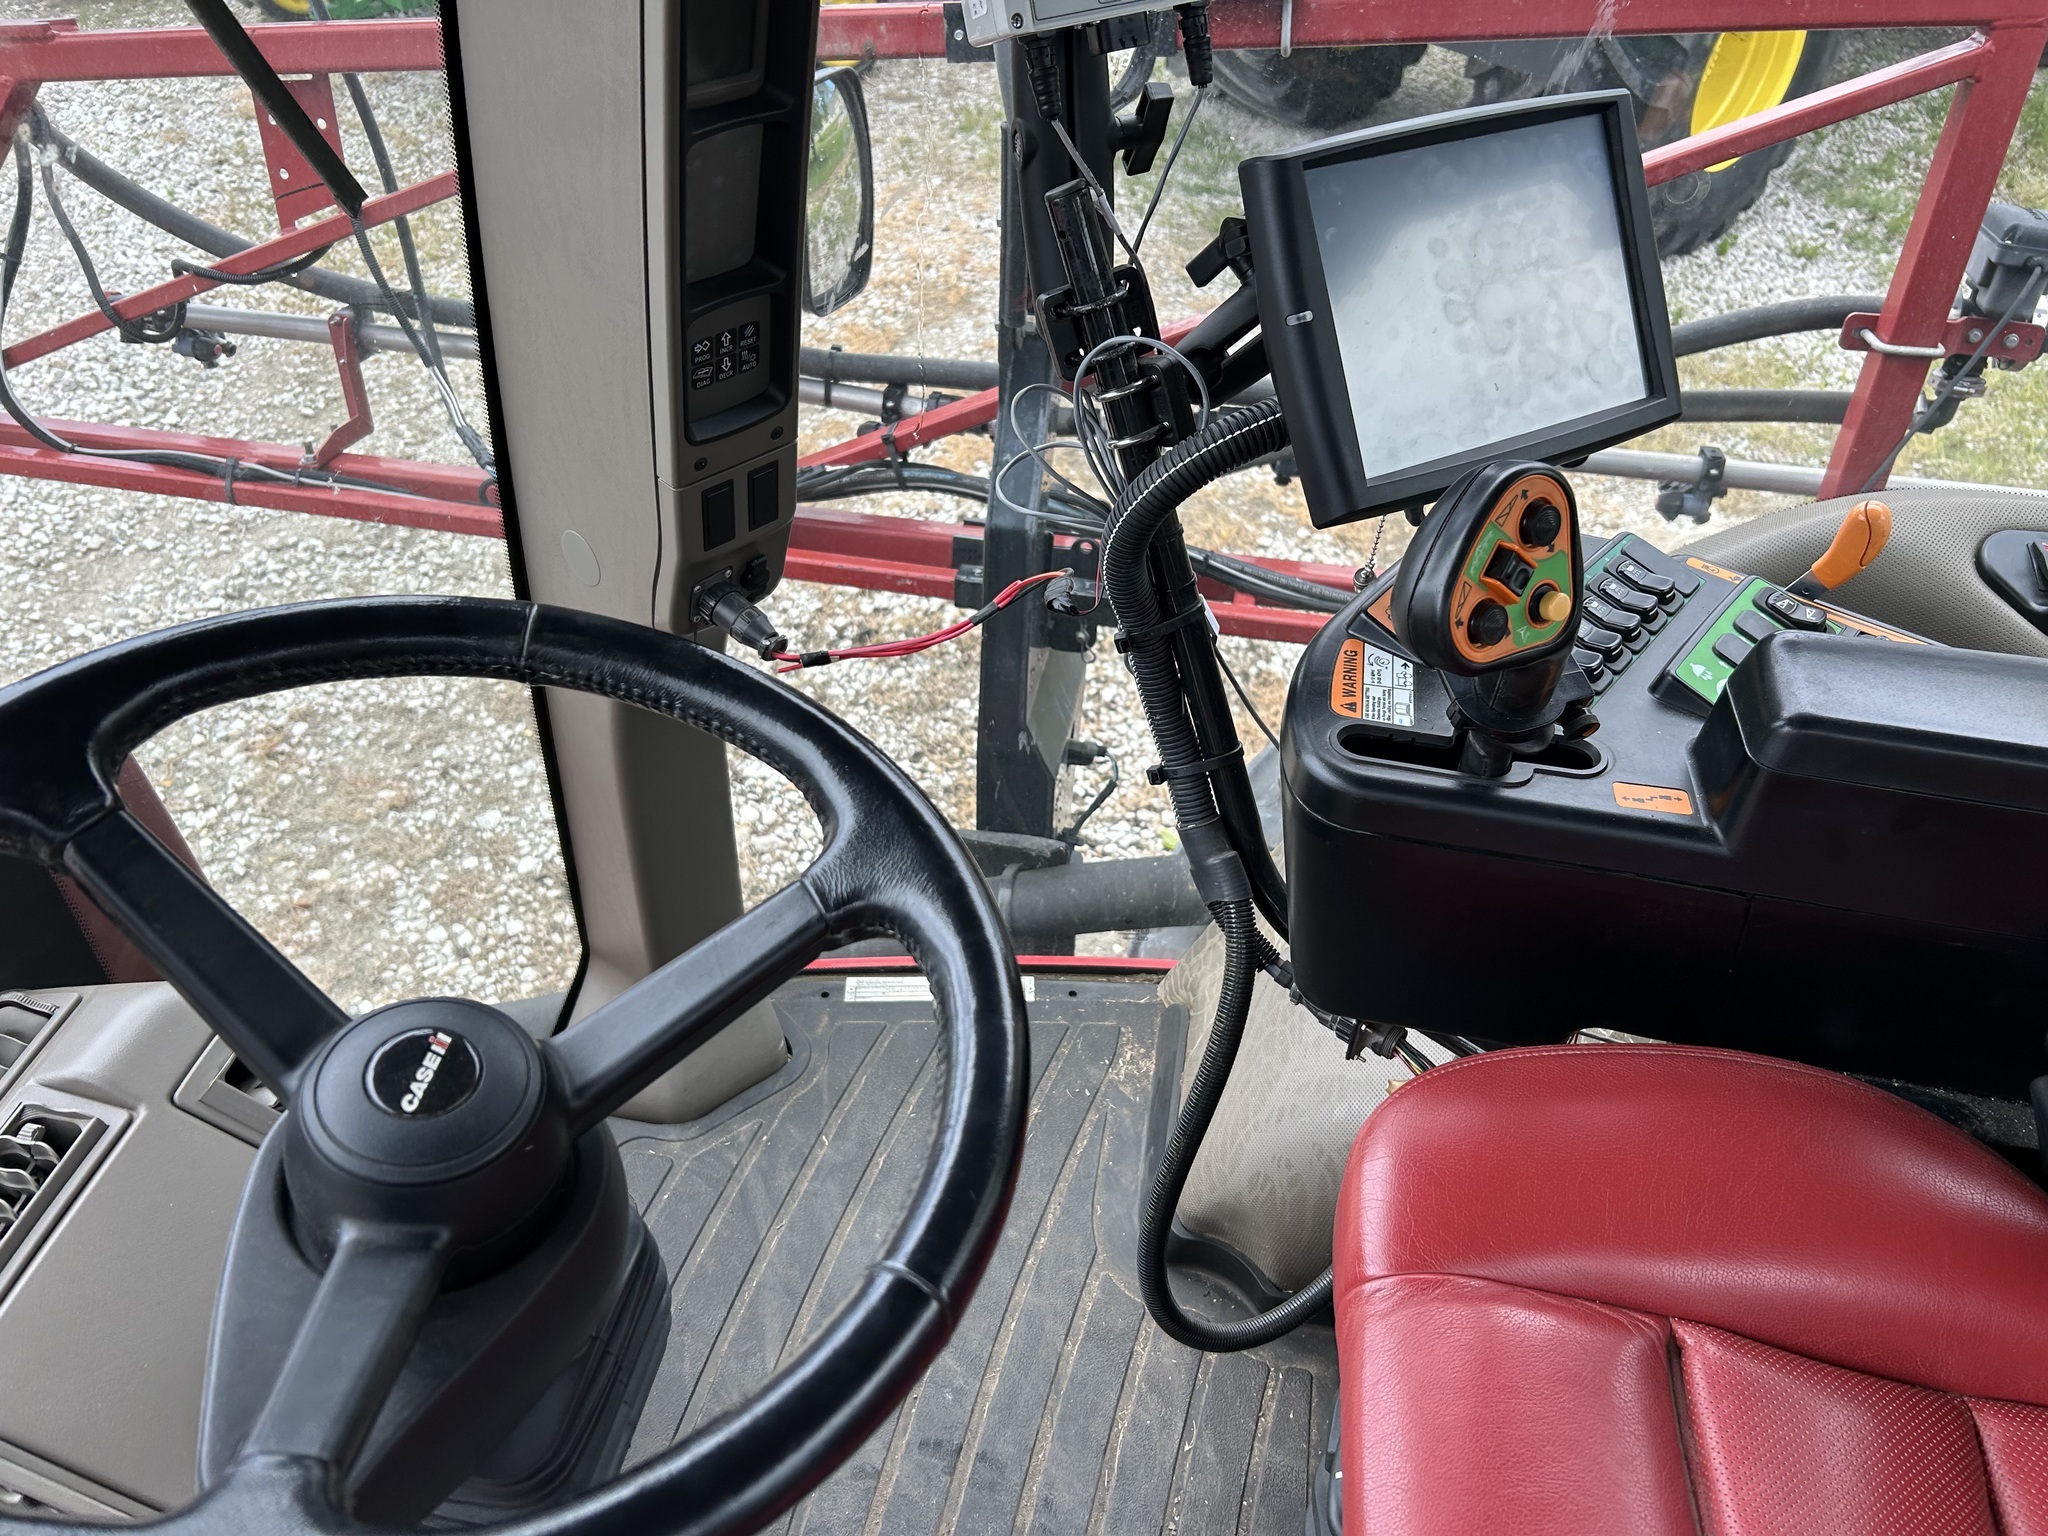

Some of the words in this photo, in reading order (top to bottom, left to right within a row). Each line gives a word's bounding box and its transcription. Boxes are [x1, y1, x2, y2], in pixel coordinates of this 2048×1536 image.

[740, 336, 757, 346] RESET
[720, 345, 733, 354] INCR
[695, 354, 710, 363] PROG
[742, 361, 757, 371] AUTO
[719, 371, 733, 380] DECR
[696, 379, 710, 388] DIAG
[1342, 650, 1358, 697] WARNING
[400, 1052, 442, 1113] CASE
